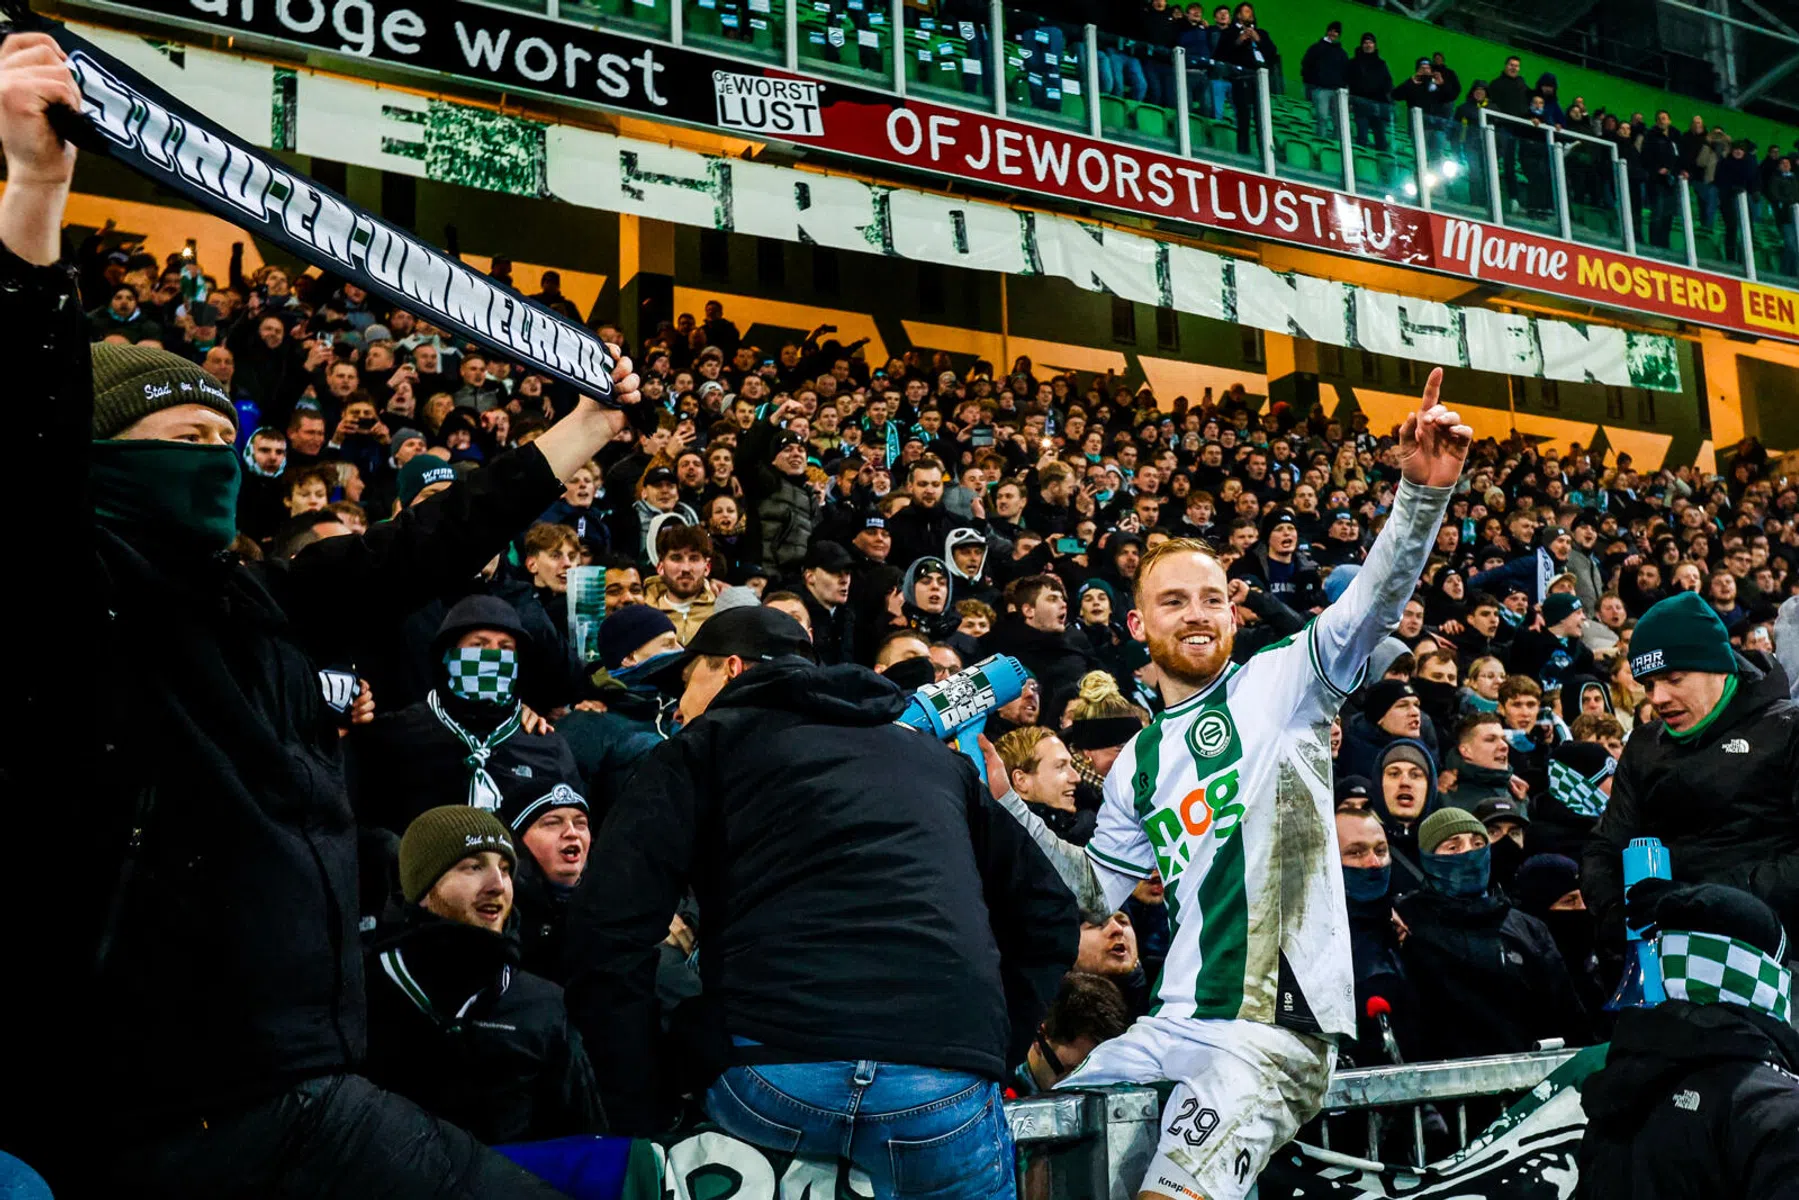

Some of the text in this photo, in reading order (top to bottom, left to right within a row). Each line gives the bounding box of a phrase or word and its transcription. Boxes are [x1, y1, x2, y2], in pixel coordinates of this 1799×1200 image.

[454, 20, 668, 106] worst
[714, 71, 730, 83] OF
[718, 84, 733, 94] JE
[733, 76, 815, 101] WORST
[718, 94, 817, 133] LUST
[1442, 219, 1795, 325] Marne MOSTERD EEN
[144, 381, 172, 400] Stad
[1167, 1098, 1220, 1146] 29
